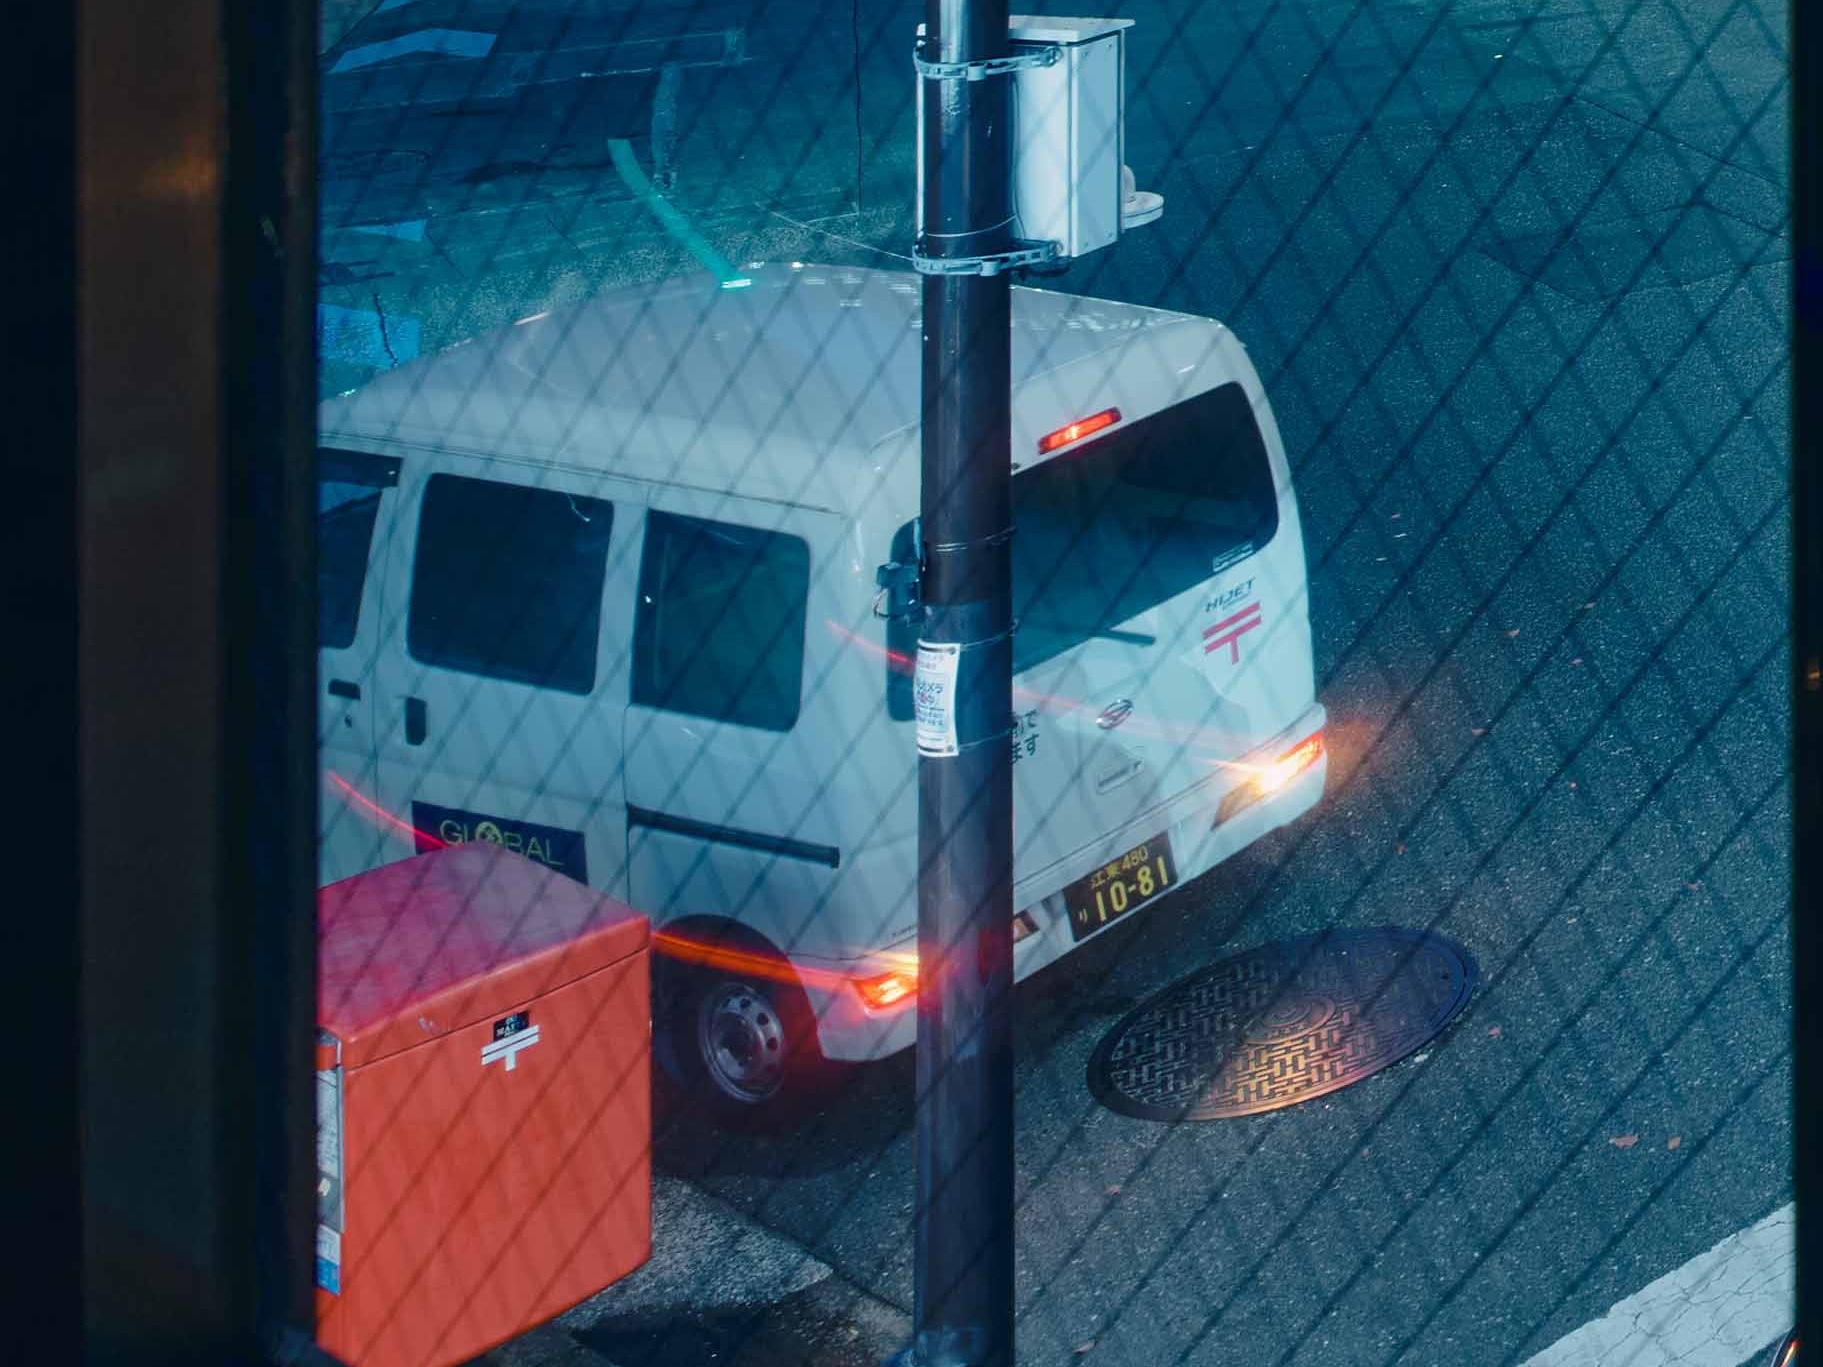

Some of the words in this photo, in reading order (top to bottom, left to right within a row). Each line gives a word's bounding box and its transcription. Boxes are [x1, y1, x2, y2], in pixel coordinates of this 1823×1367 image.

[1204, 577, 1256, 613] HIJET
[439, 818, 566, 866] GLOBAL
[1095, 854, 1169, 923] 10-81
